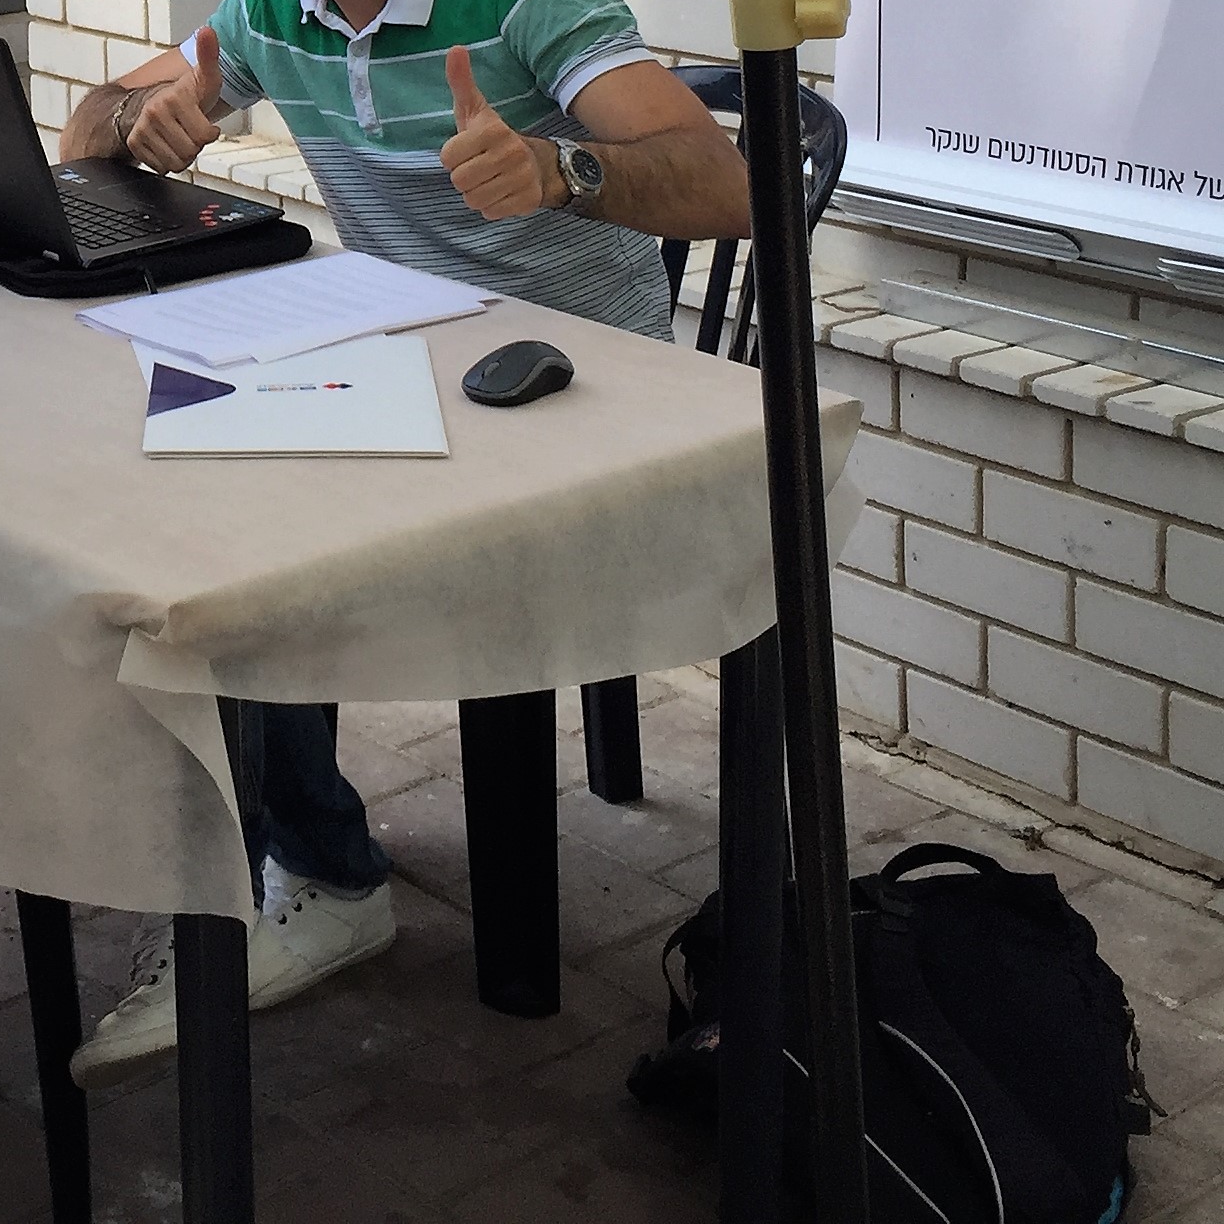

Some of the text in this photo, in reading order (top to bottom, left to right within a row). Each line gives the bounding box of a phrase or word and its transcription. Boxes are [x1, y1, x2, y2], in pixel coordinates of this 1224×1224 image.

[925, 126, 980, 154] שנקר
[988, 137, 1107, 179] הסטודנטים
[1115, 160, 1185, 194] אגודת
